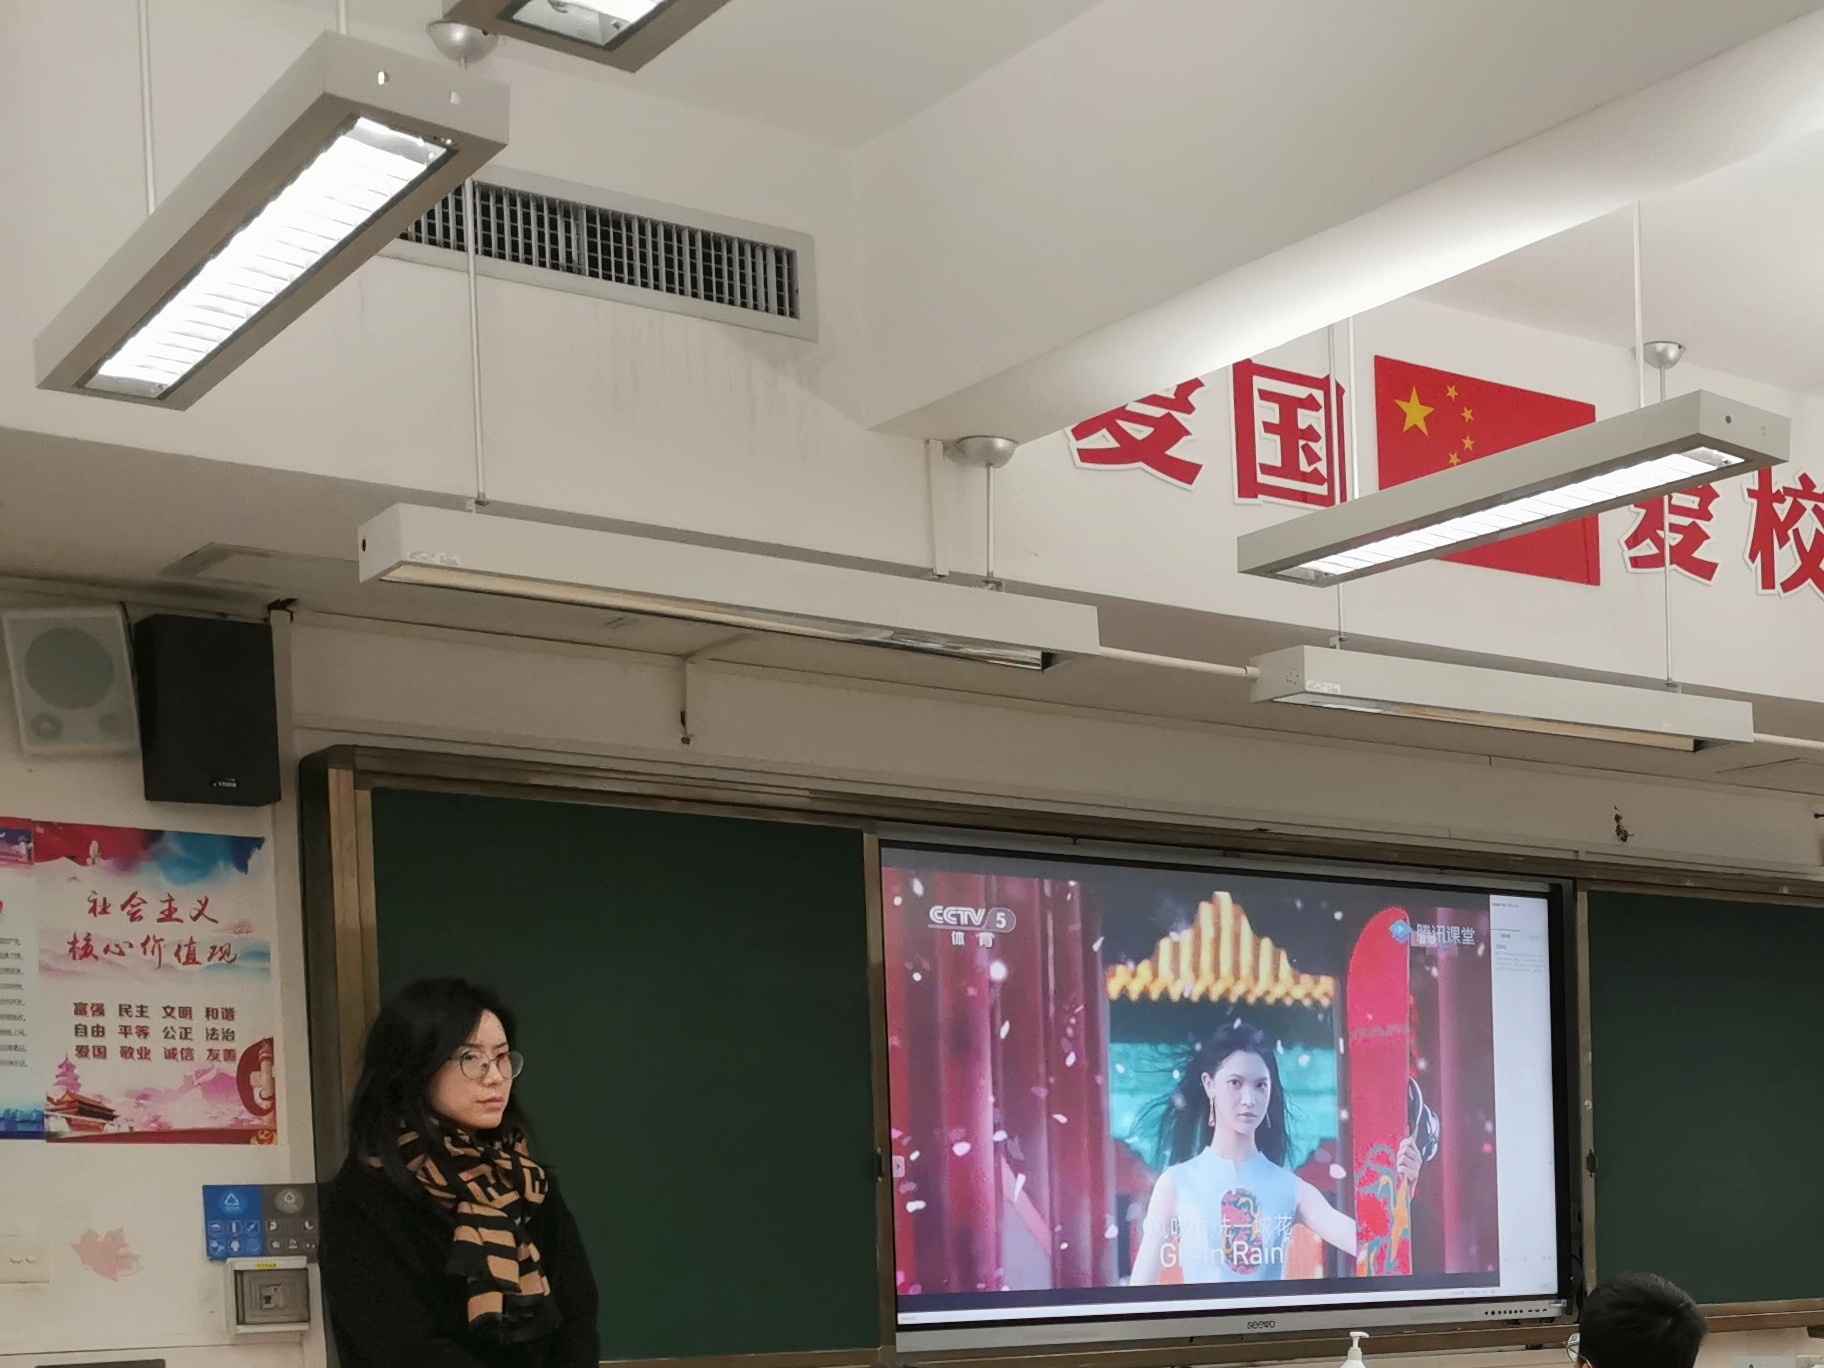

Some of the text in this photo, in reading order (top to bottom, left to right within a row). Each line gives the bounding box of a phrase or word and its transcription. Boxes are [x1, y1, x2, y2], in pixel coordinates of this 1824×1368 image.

[87, 889, 219, 924] 社会主义
[929, 904, 1007, 929] CCTV 5
[1416, 923, 1476, 946] 腾讯课堂
[73, 1001, 236, 1022] 富强 民主 文明 和谐
[74, 1023, 236, 1042] 自由 平等 公正 法治
[75, 1044, 237, 1063] 爱国 敬业 诚信 友善
[1232, 1240, 1284, 1266] Rain
[1246, 1319, 1276, 1330] seewo
